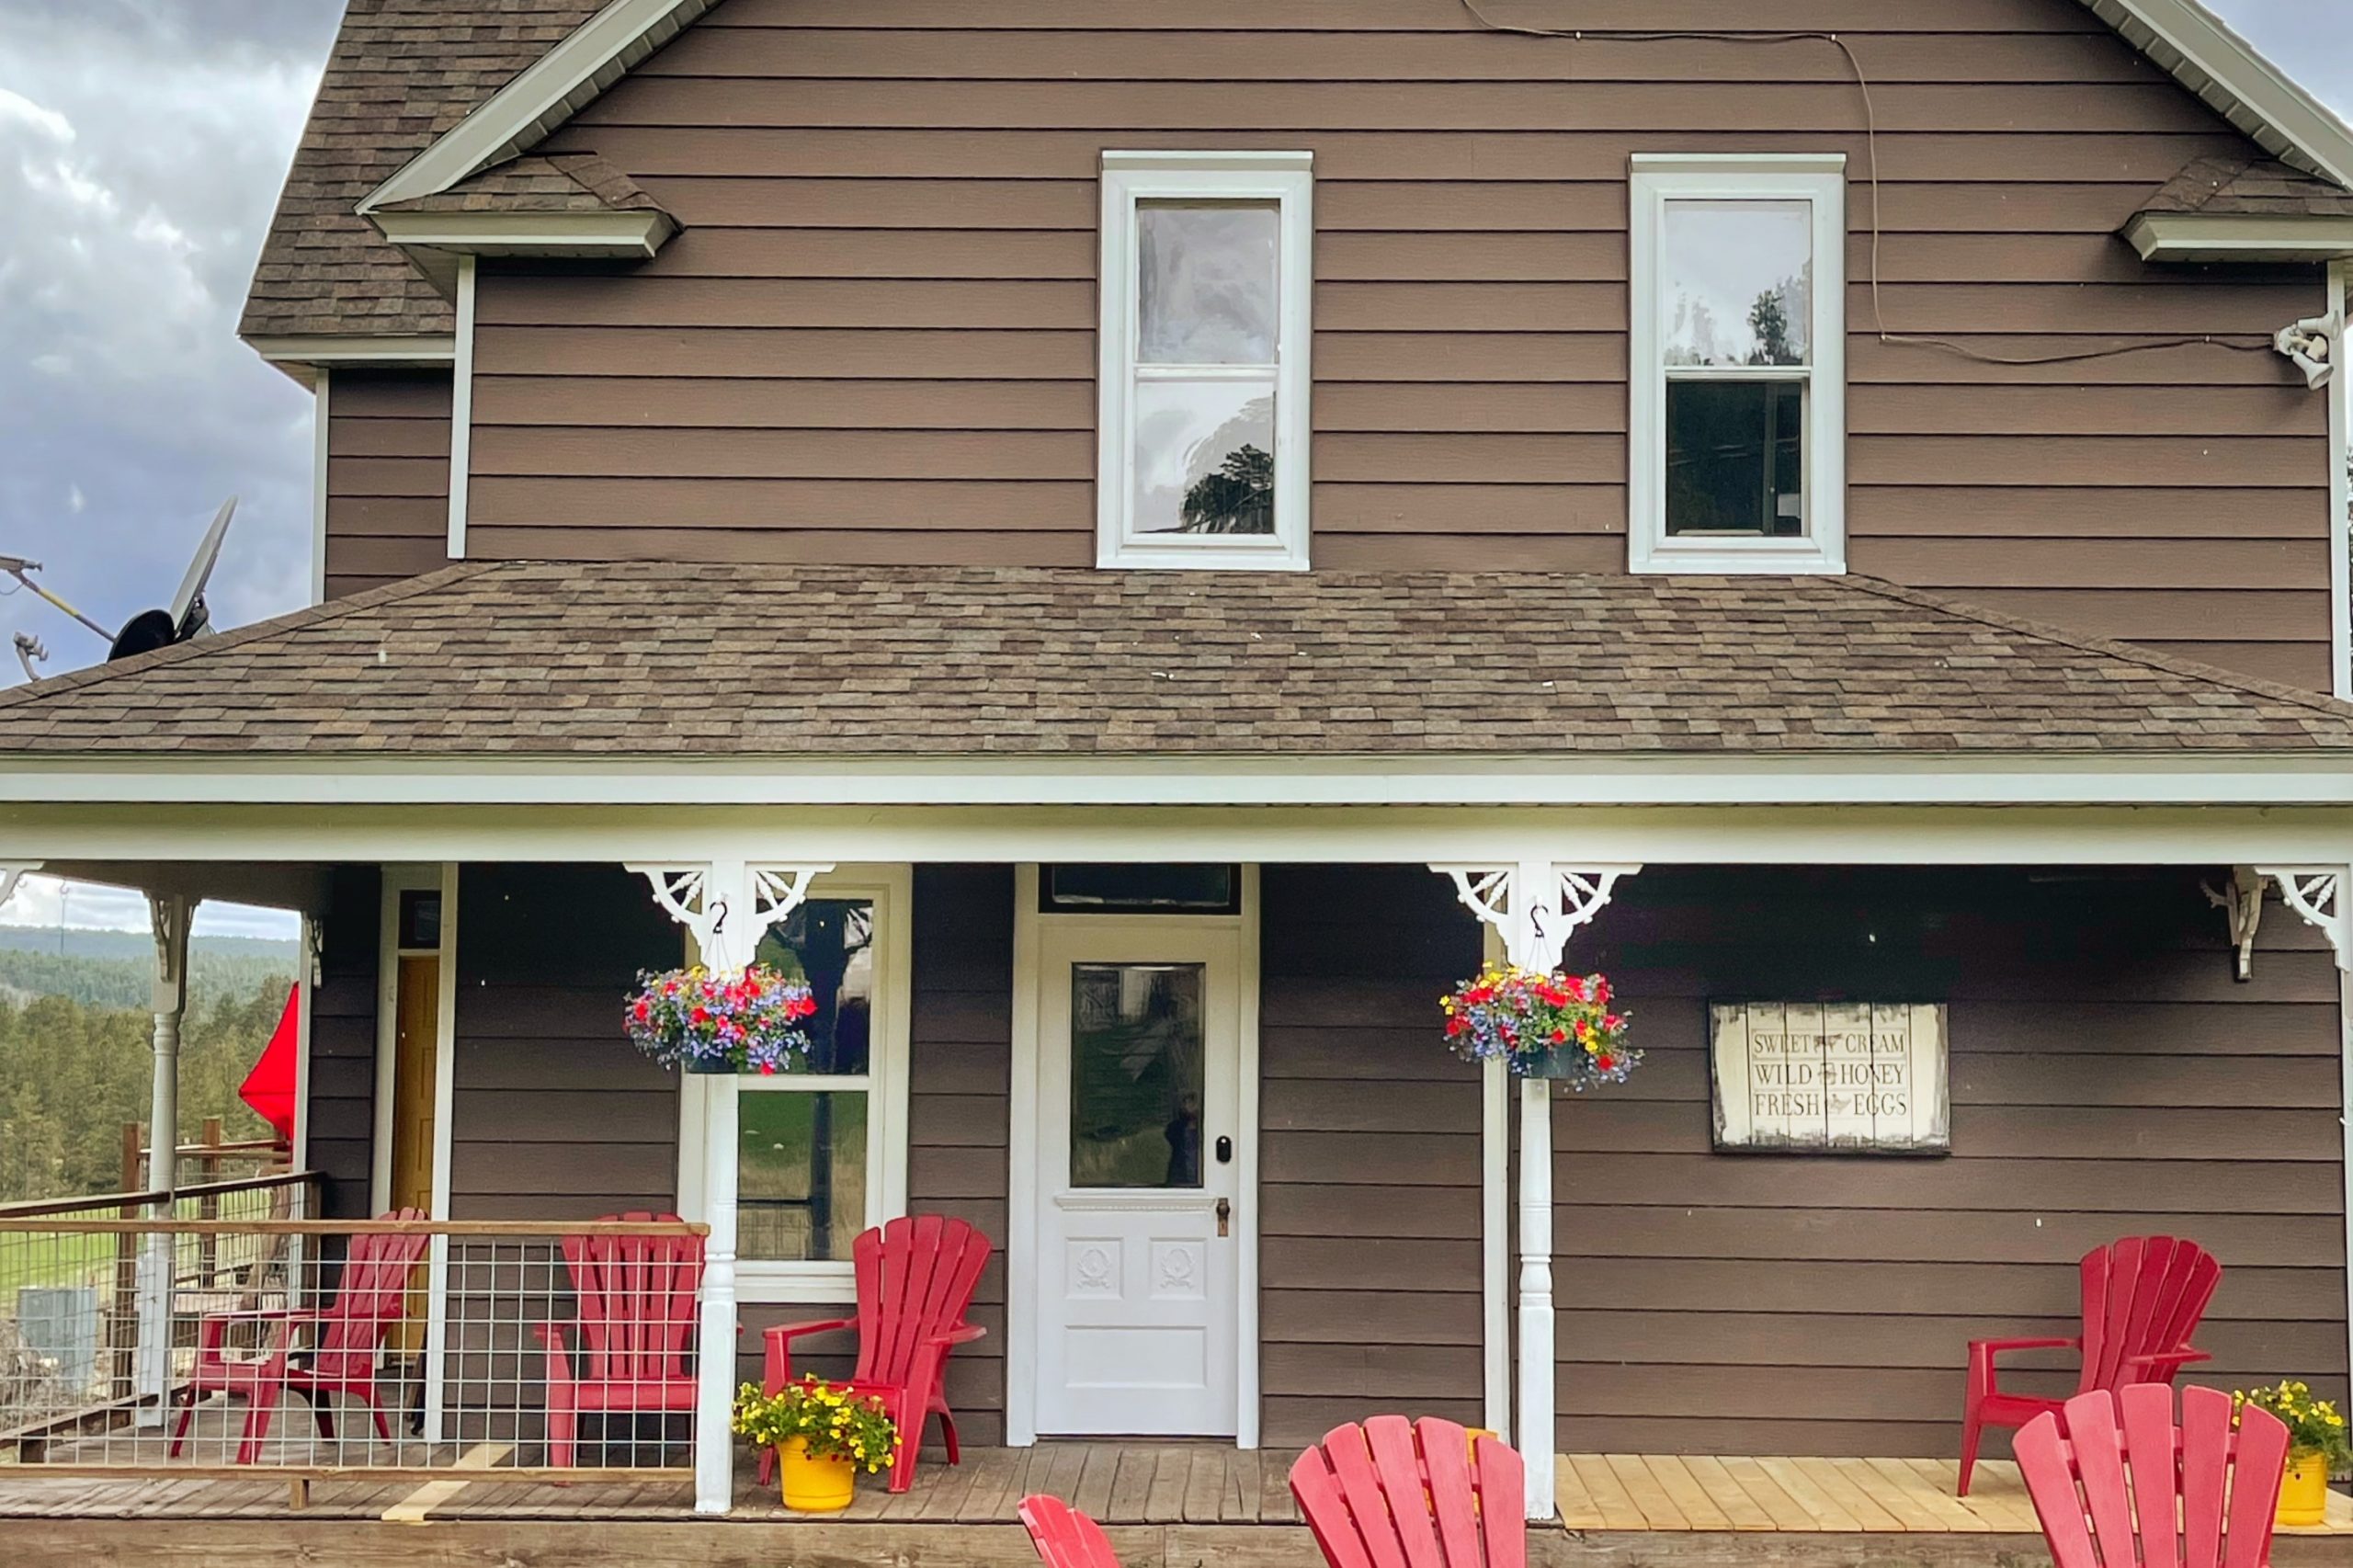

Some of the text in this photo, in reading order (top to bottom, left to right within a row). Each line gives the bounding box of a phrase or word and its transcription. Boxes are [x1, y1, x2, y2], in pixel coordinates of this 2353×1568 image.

[1754, 1033, 1904, 1053] SWEET CREAM
[1754, 1063, 1905, 1085] WILD HONEY
[1754, 1093, 1907, 1116] FRESH EGGS
